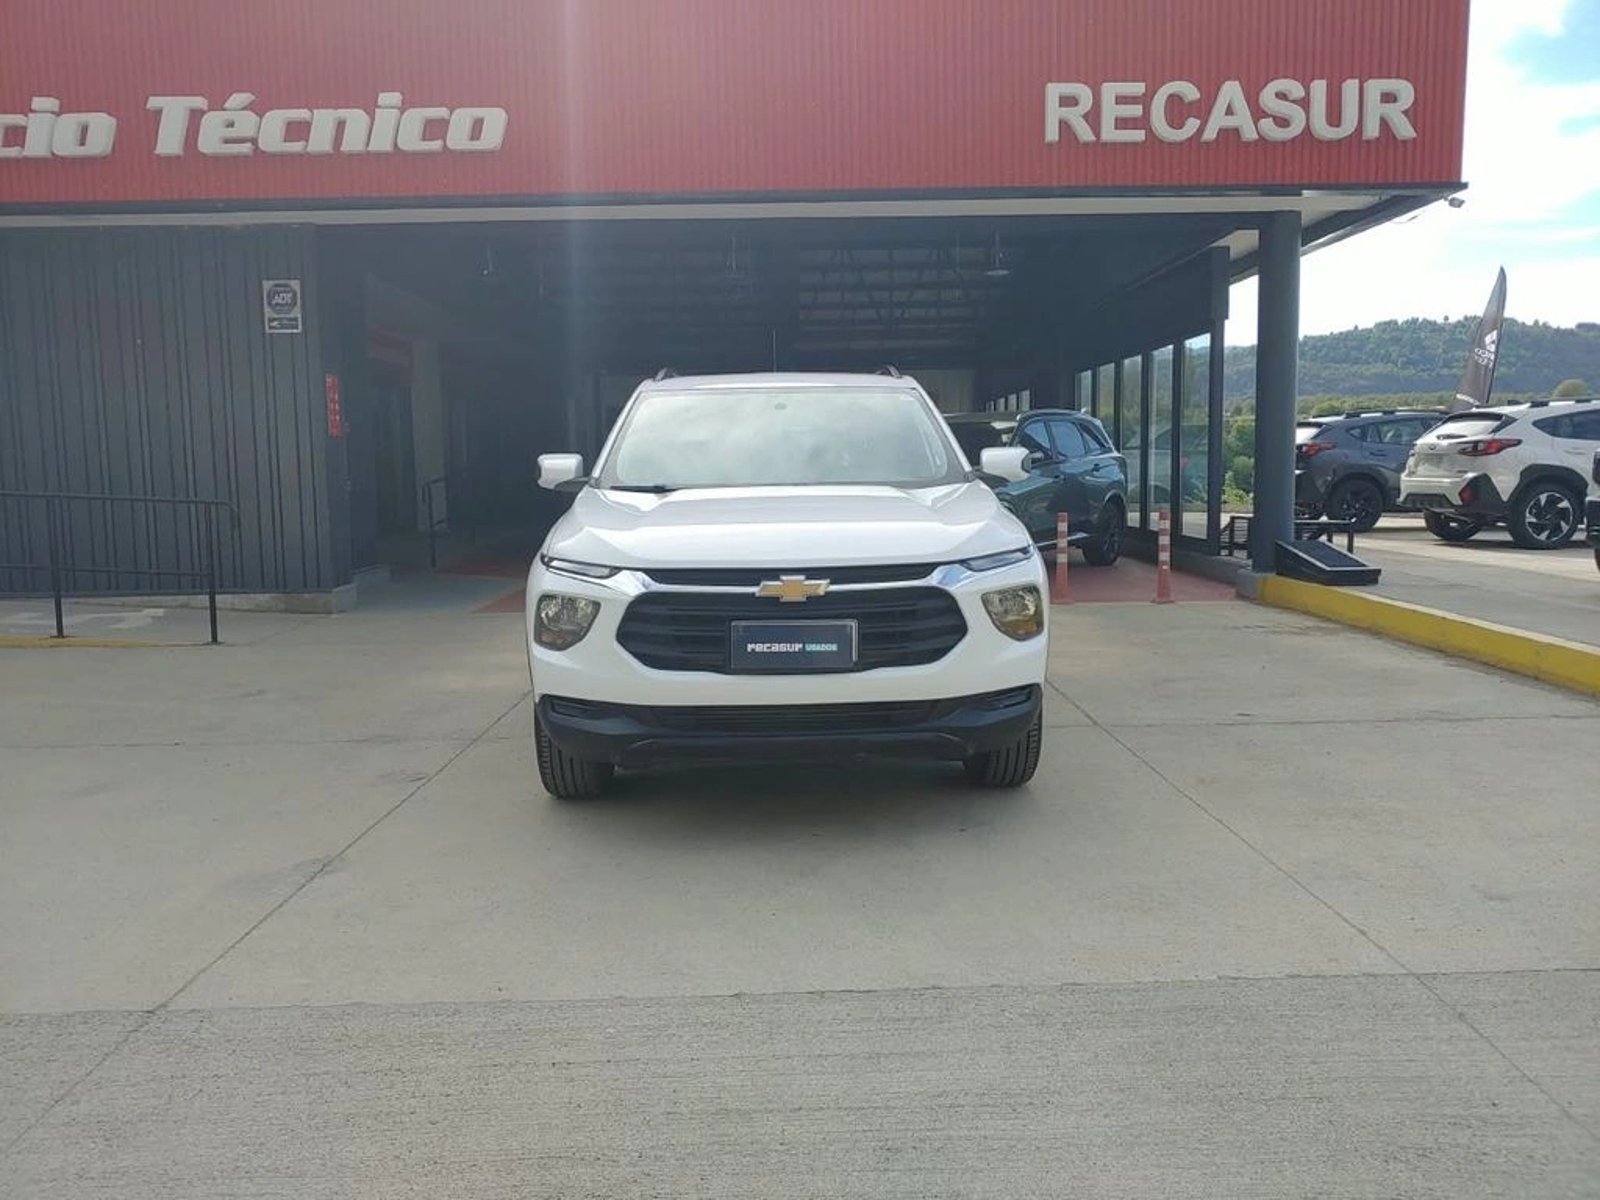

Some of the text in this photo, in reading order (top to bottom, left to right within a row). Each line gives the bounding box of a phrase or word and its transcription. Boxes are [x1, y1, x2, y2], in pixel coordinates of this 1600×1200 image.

[146, 91, 509, 157] Técnico
[1045, 78, 1417, 143] RECASUR
[747, 643, 803, 652] recasur
